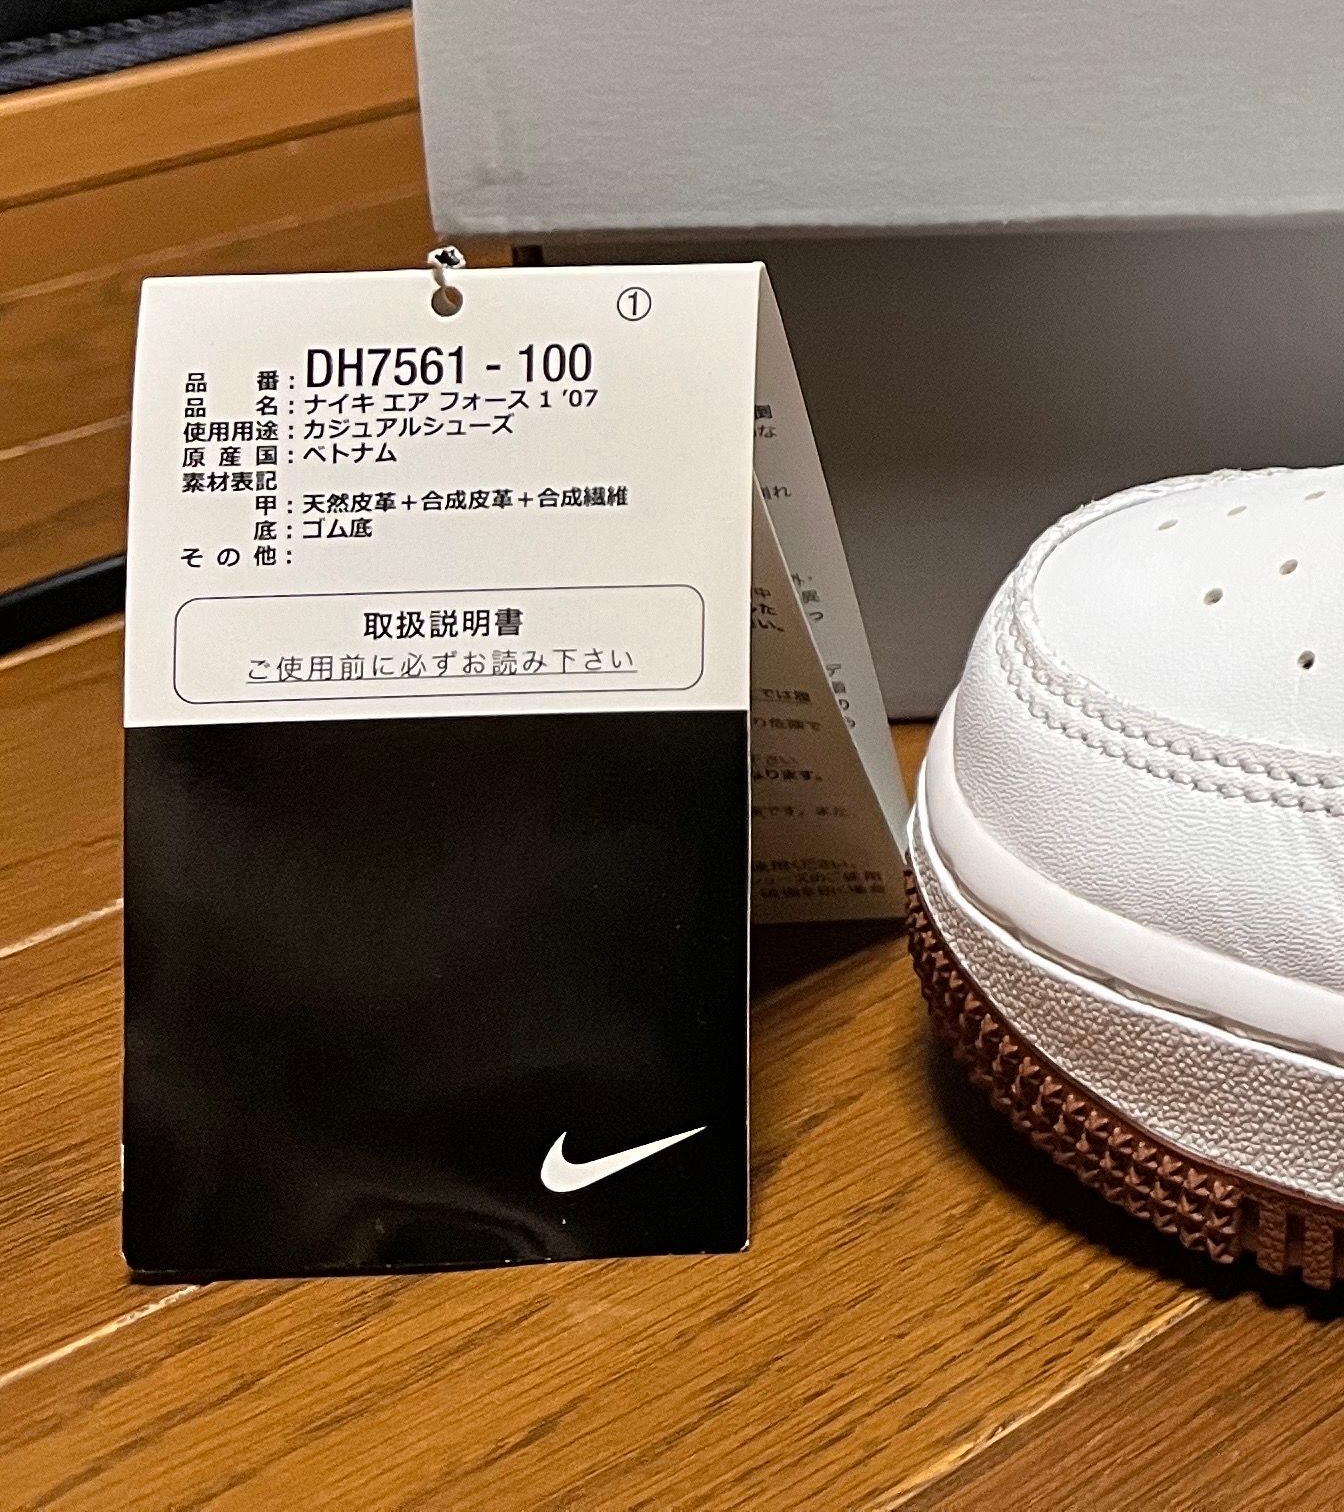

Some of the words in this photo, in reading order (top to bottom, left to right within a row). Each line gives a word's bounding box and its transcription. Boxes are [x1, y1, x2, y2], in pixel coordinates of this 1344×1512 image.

[307, 346, 462, 387] DH7561
[519, 343, 591, 382] 100
[364, 608, 523, 640] 取扱説明書
[248, 649, 634, 682] ご使用前に必ずお読み下さい
